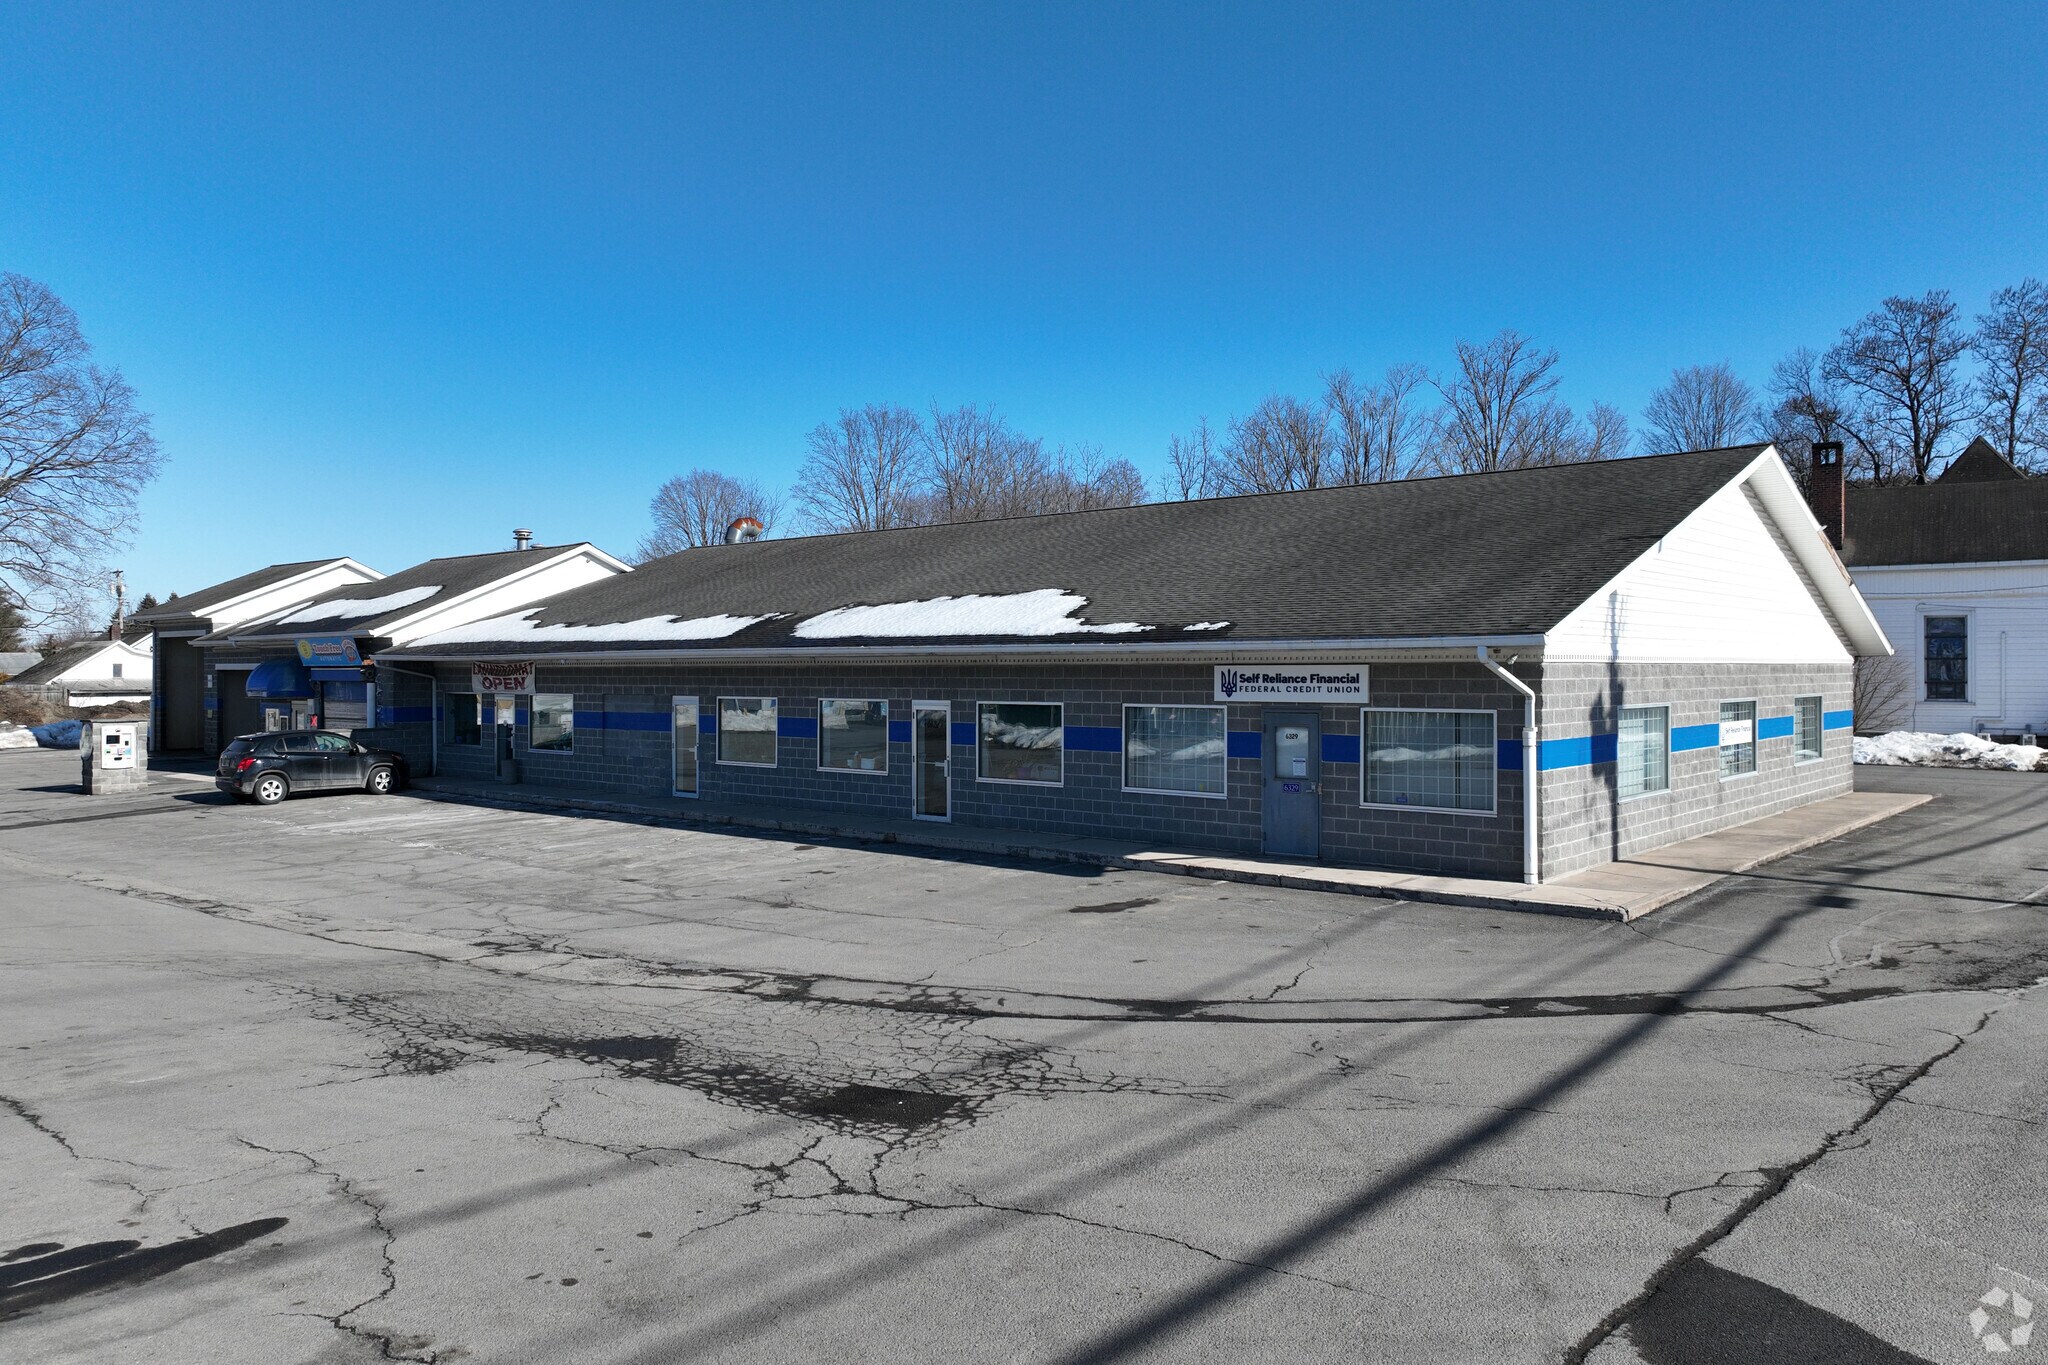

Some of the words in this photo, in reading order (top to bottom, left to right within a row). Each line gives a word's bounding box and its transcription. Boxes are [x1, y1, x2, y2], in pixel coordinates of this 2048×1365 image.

[1239, 673, 1260, 684] Self
[1262, 673, 1308, 684] Reliance
[1309, 673, 1360, 684] Financial
[482, 677, 527, 690] OPEN
[1239, 685, 1282, 693] FEDERAL
[1285, 685, 1322, 693] CREDIT
[1284, 784, 1299, 792] 6329
